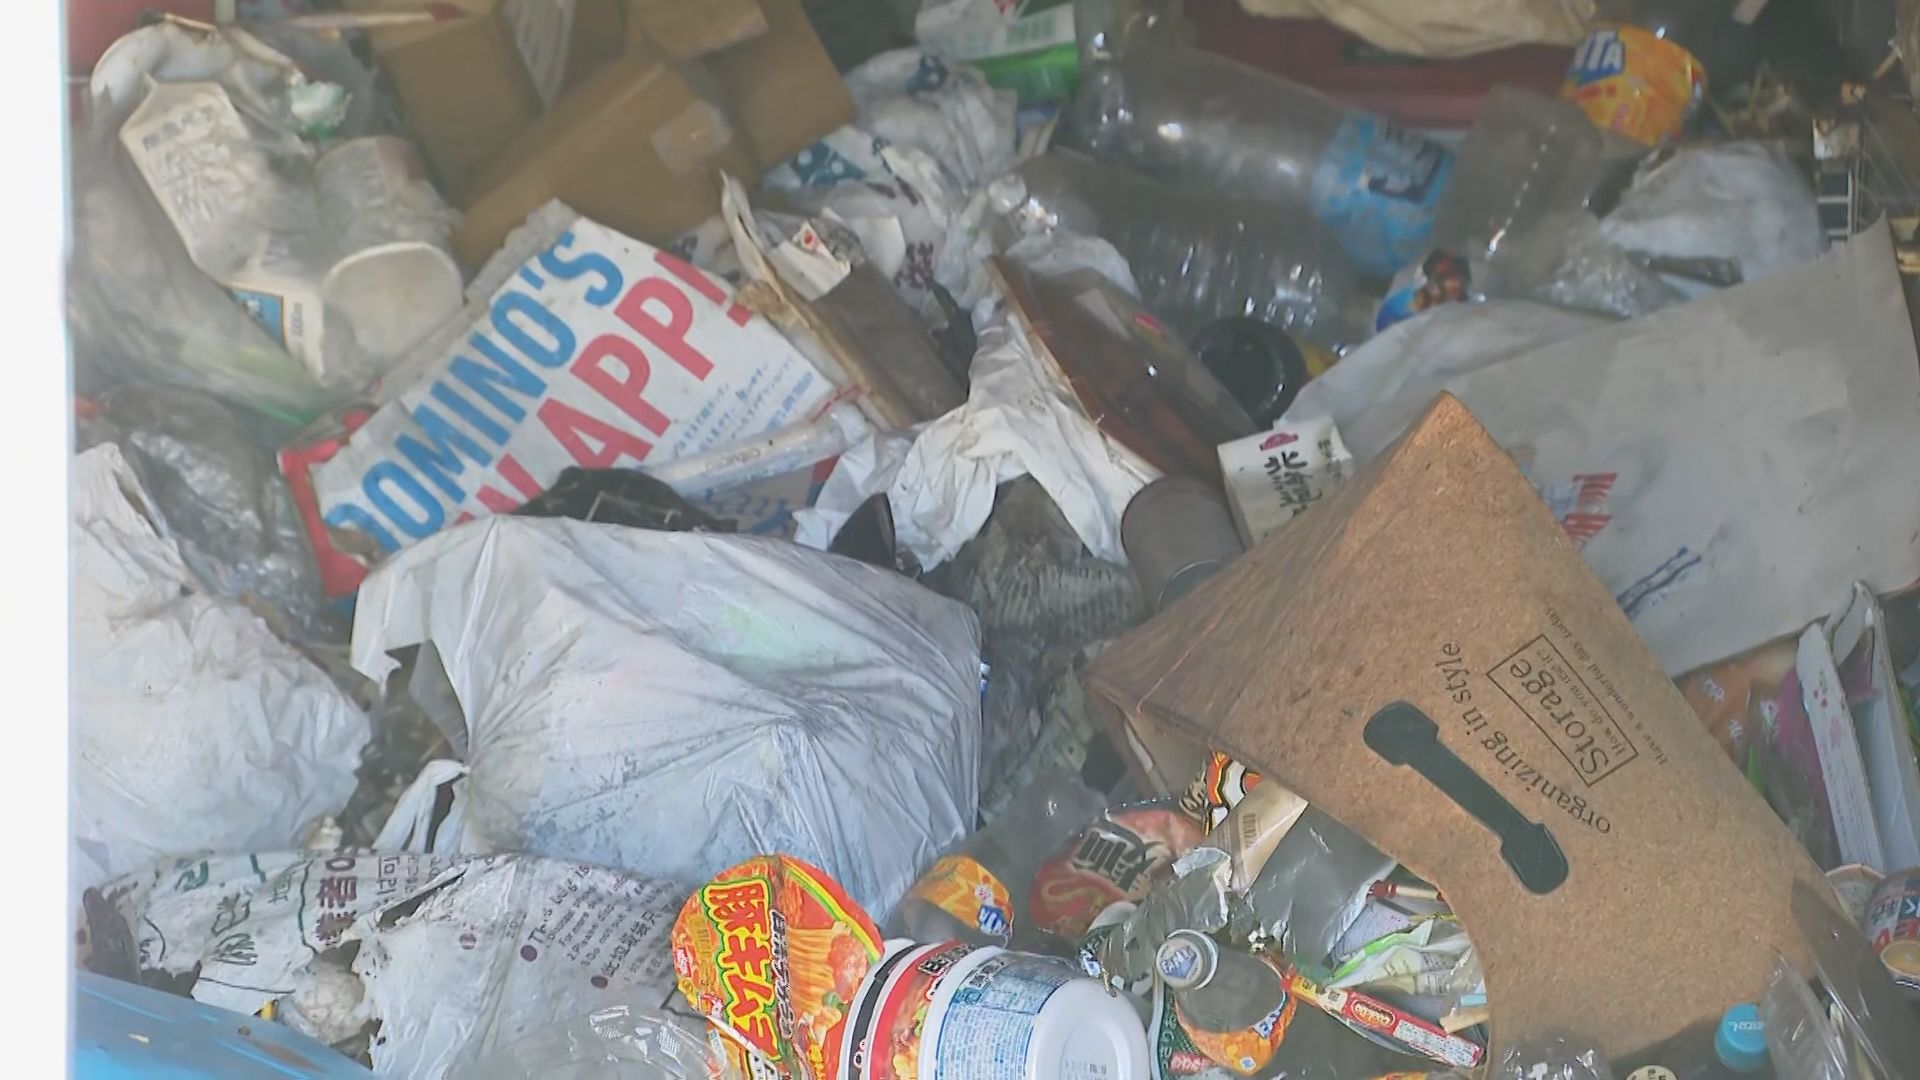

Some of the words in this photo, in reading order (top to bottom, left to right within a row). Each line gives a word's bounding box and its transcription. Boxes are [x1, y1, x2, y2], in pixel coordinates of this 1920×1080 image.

[538, 249, 753, 470] APP!
[1435, 642, 1471, 704] style
[1550, 662, 1571, 685] use
[1567, 681, 1594, 708] you
[1587, 663, 1635, 722] wonderful
[1462, 707, 1489, 737] in
[1509, 658, 1610, 775] Storage
[1585, 707, 1604, 727] do
[1603, 728, 1625, 755] How
[1641, 733, 1669, 766] Have
[1482, 731, 1610, 833] organizing
[708, 883, 780, 1059] 豚キムチ
